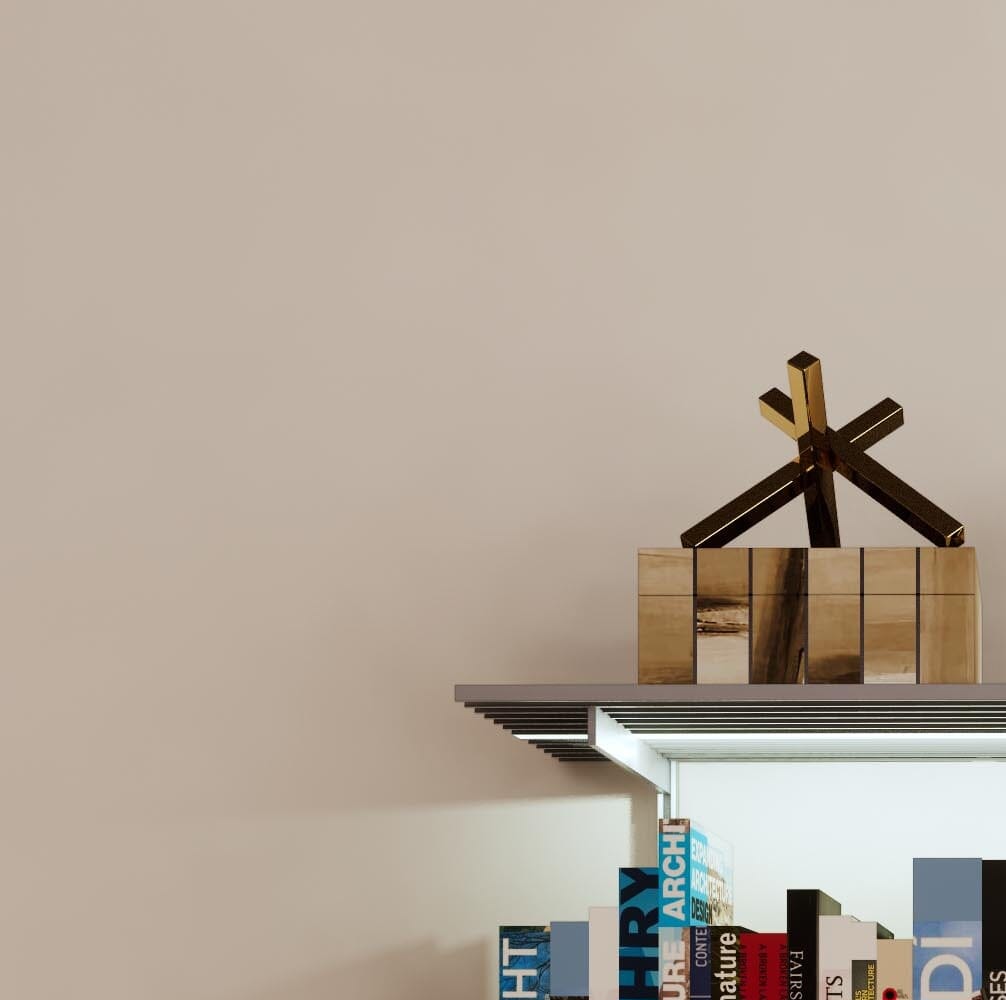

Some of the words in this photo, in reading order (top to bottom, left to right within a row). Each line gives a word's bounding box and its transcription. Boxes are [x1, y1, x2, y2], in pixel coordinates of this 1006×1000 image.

[691, 896, 713, 925] DESIGN
[695, 926, 708, 967] CONTE
[788, 951, 803, 1000] FAIRS
